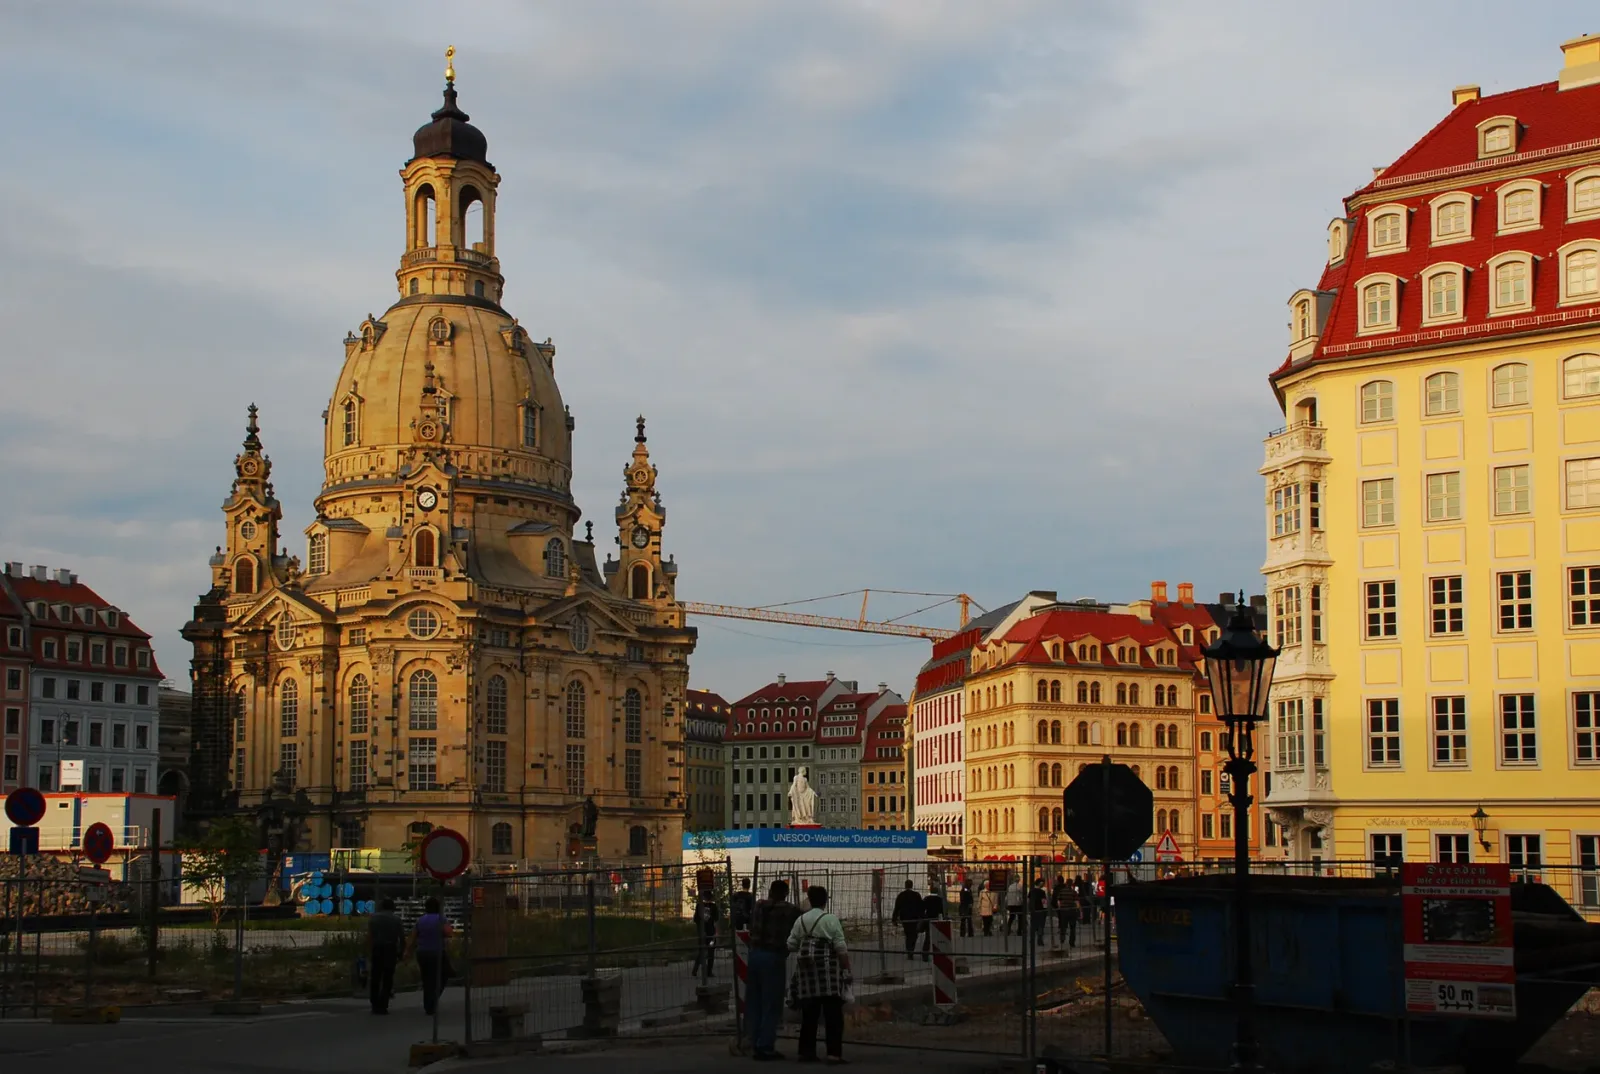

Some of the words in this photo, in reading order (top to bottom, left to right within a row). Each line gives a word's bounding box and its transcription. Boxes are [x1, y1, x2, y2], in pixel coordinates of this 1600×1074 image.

[772, 833, 850, 843] UNESCO-Welterbe
[851, 834, 890, 844] "Dresdner
[891, 834, 916, 844] Elbtal"
[1426, 865, 1487, 875] Dresden
[1416, 876, 1433, 885] wie
[1436, 877, 1447, 885] es
[1450, 876, 1475, 885] einst
[1478, 877, 1497, 886] war
[1438, 984, 1455, 1000] 50
[1461, 988, 1474, 1001] m
